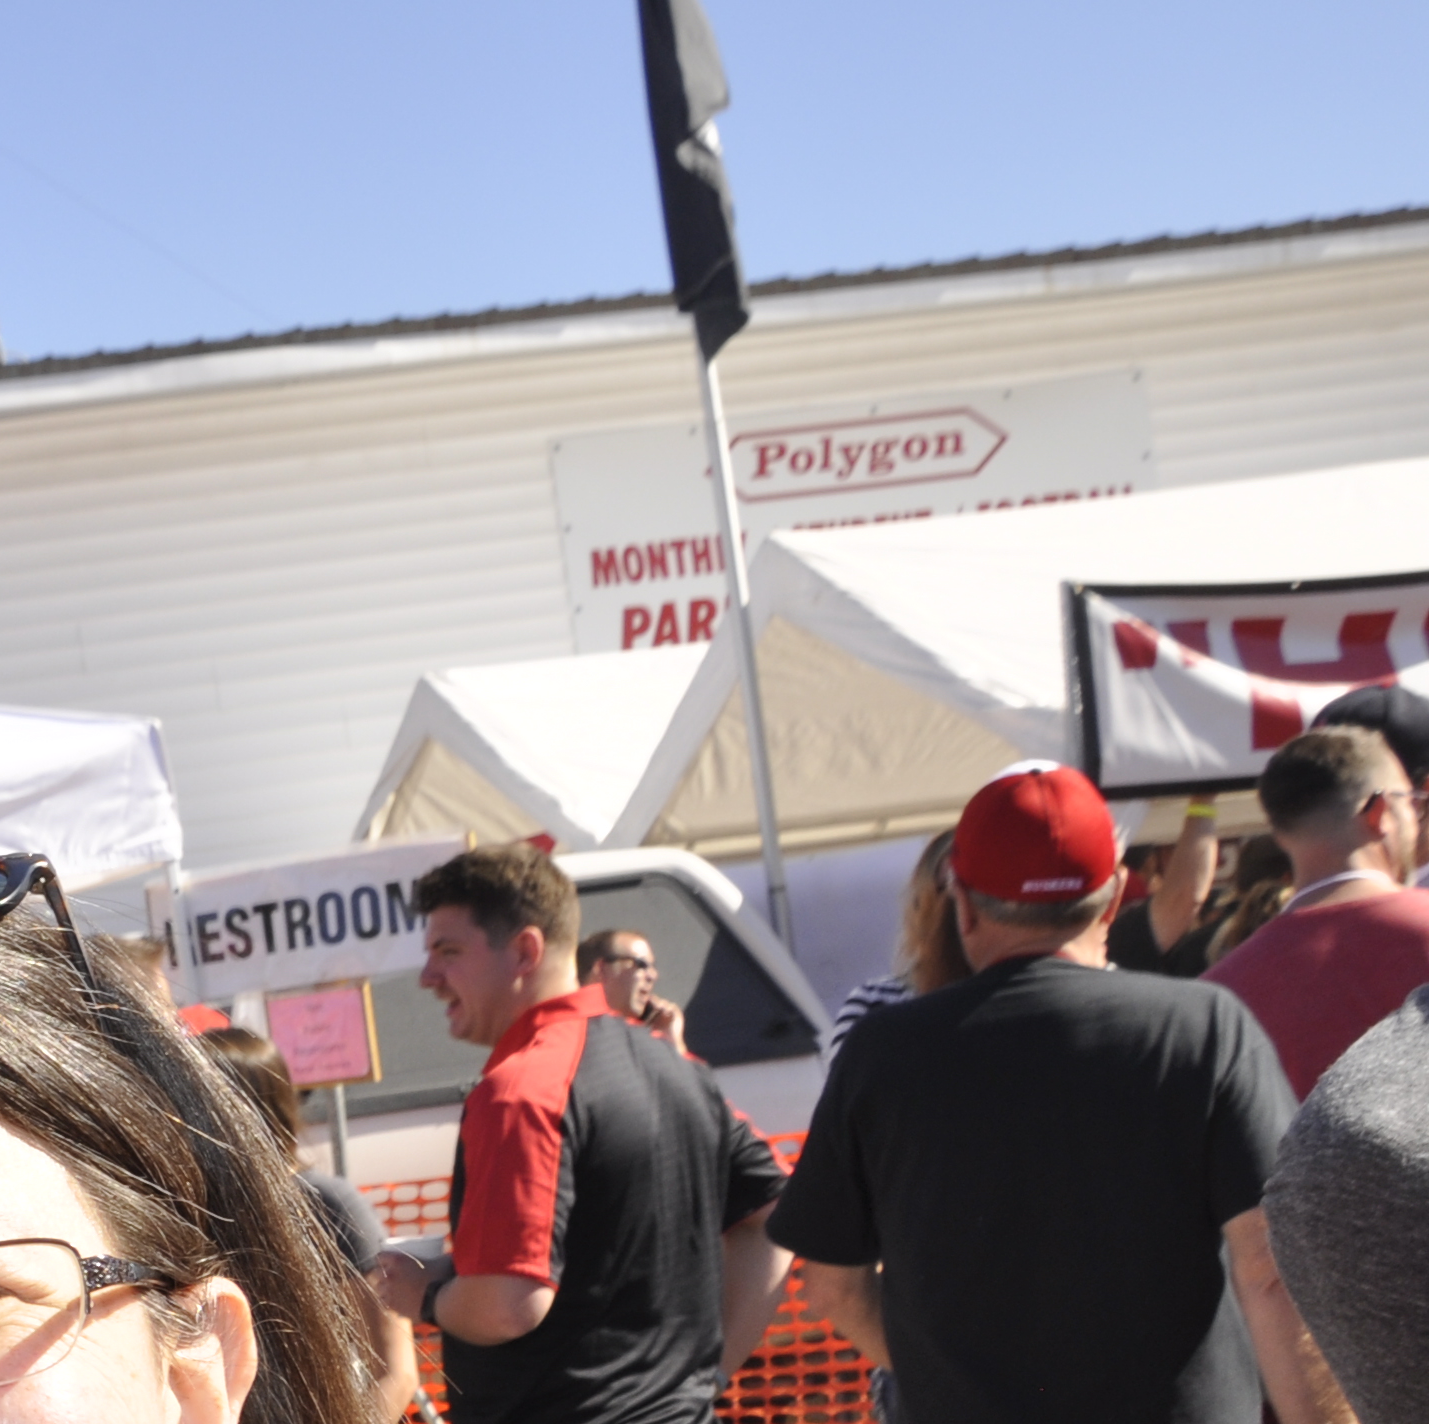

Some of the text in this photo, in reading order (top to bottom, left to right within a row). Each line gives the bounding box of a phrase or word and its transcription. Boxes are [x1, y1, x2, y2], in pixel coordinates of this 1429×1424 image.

[751, 428, 964, 481] Polygon
[590, 530, 747, 589] MONTH
[619, 592, 731, 651] PAR
